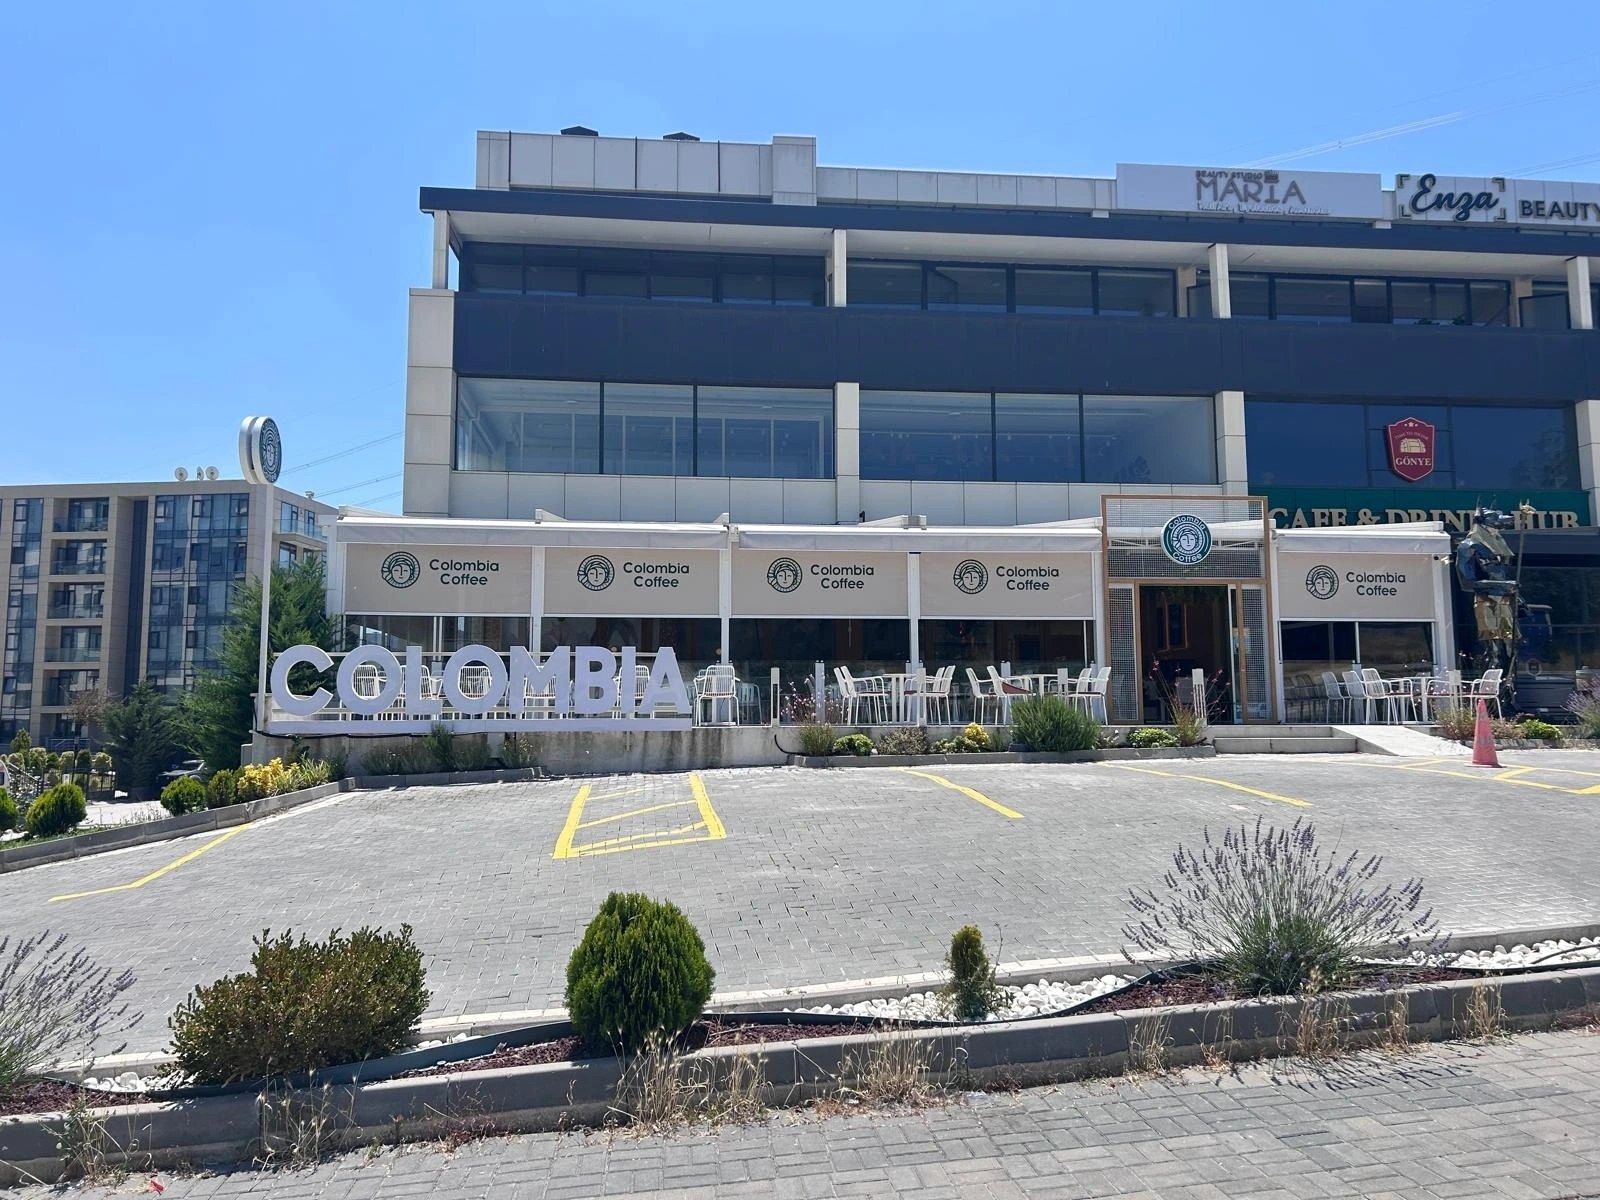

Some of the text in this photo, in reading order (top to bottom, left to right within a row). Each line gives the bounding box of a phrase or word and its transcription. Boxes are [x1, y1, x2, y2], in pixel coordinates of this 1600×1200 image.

[1231, 171, 1263, 181] STUDIO
[1196, 176, 1307, 205] MARIA
[1411, 174, 1500, 222] Enza
[1519, 200, 1600, 220] BEAUTY
[1395, 456, 1431, 466] GÖNYE
[1357, 508, 1381, 525] &
[1168, 516, 1206, 530] Colombia
[429, 559, 499, 572] Colombia
[623, 562, 690, 575] Colombia
[810, 564, 874, 576] Colombia
[996, 566, 1059, 578] Colombia
[1345, 571, 1406, 583] Colombia
[440, 573, 488, 586] Coffee
[634, 576, 679, 588] Coffee
[821, 577, 864, 589] Coffee
[1006, 579, 1050, 591] Coffee
[1356, 584, 1397, 596] Coffee
[270, 644, 692, 717] COLOMBIA
